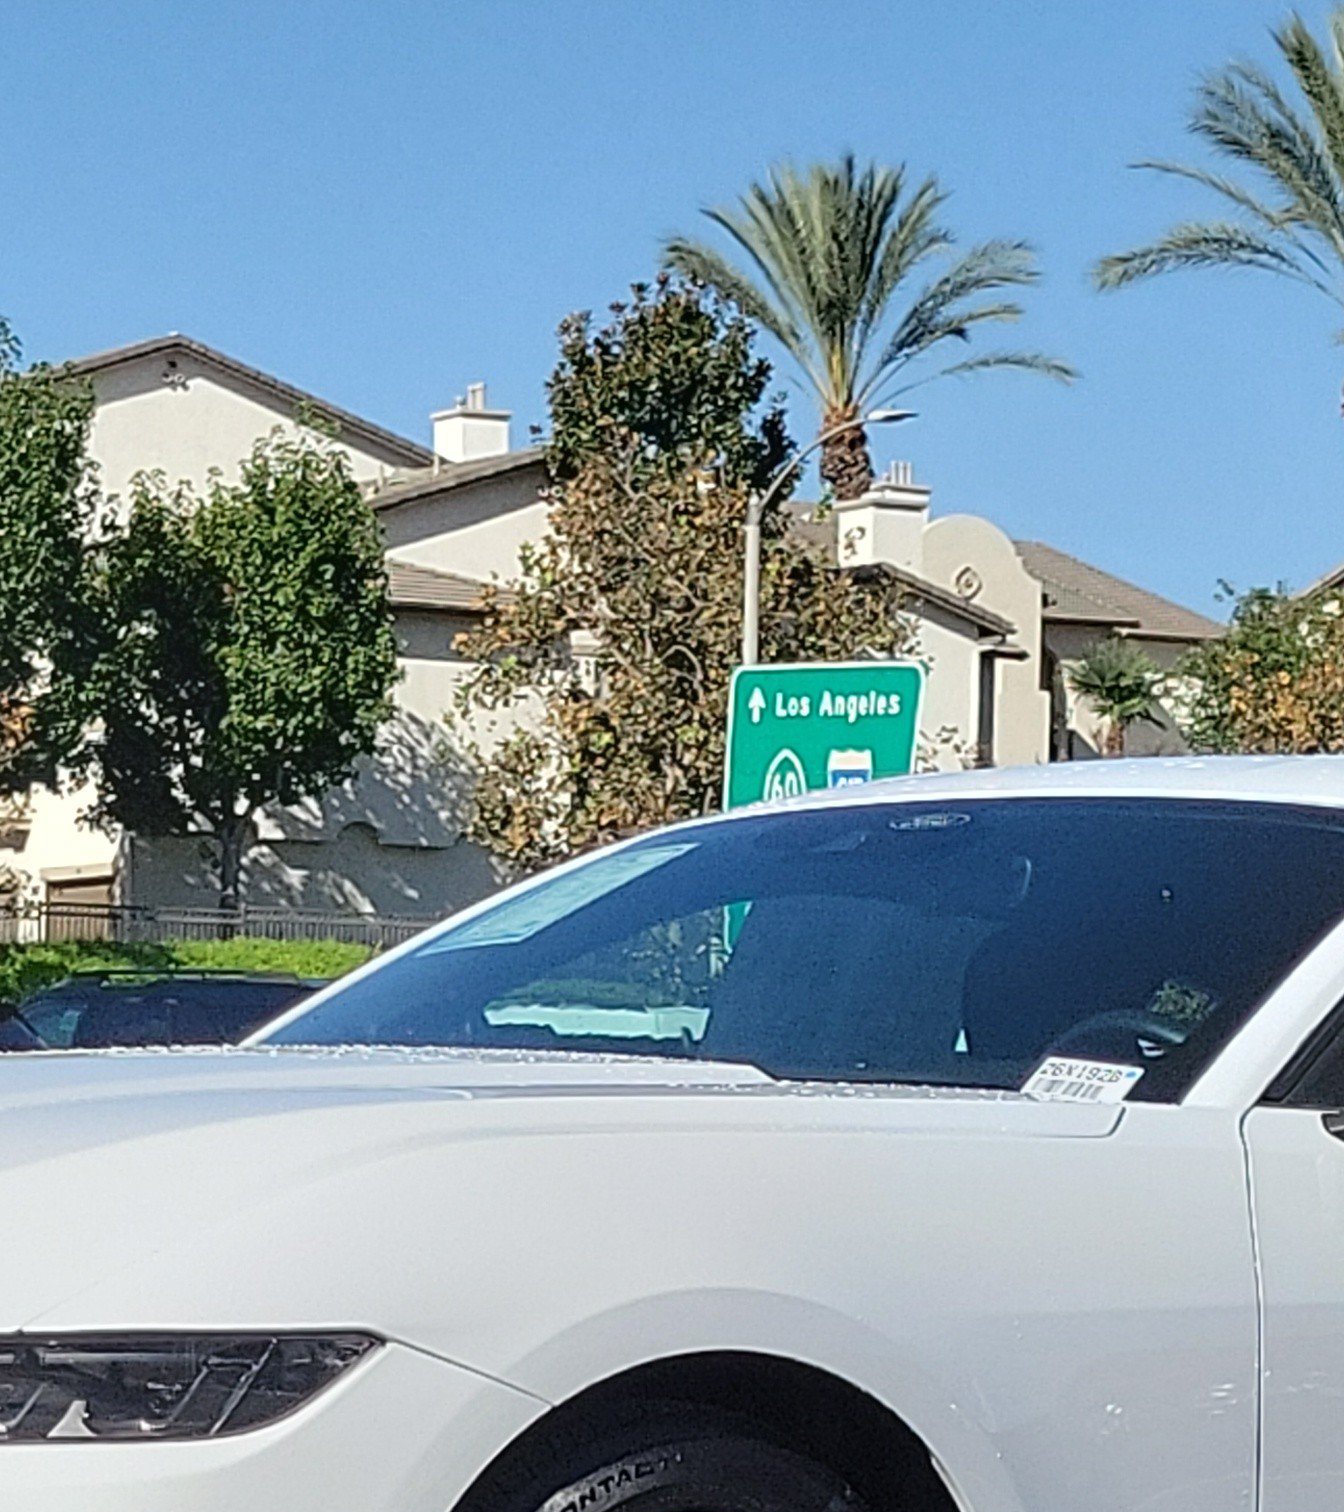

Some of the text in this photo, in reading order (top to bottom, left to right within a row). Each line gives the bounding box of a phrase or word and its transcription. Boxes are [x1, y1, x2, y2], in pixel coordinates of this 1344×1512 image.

[775, 690, 901, 724] Los Angeles
[772, 771, 798, 801] 60
